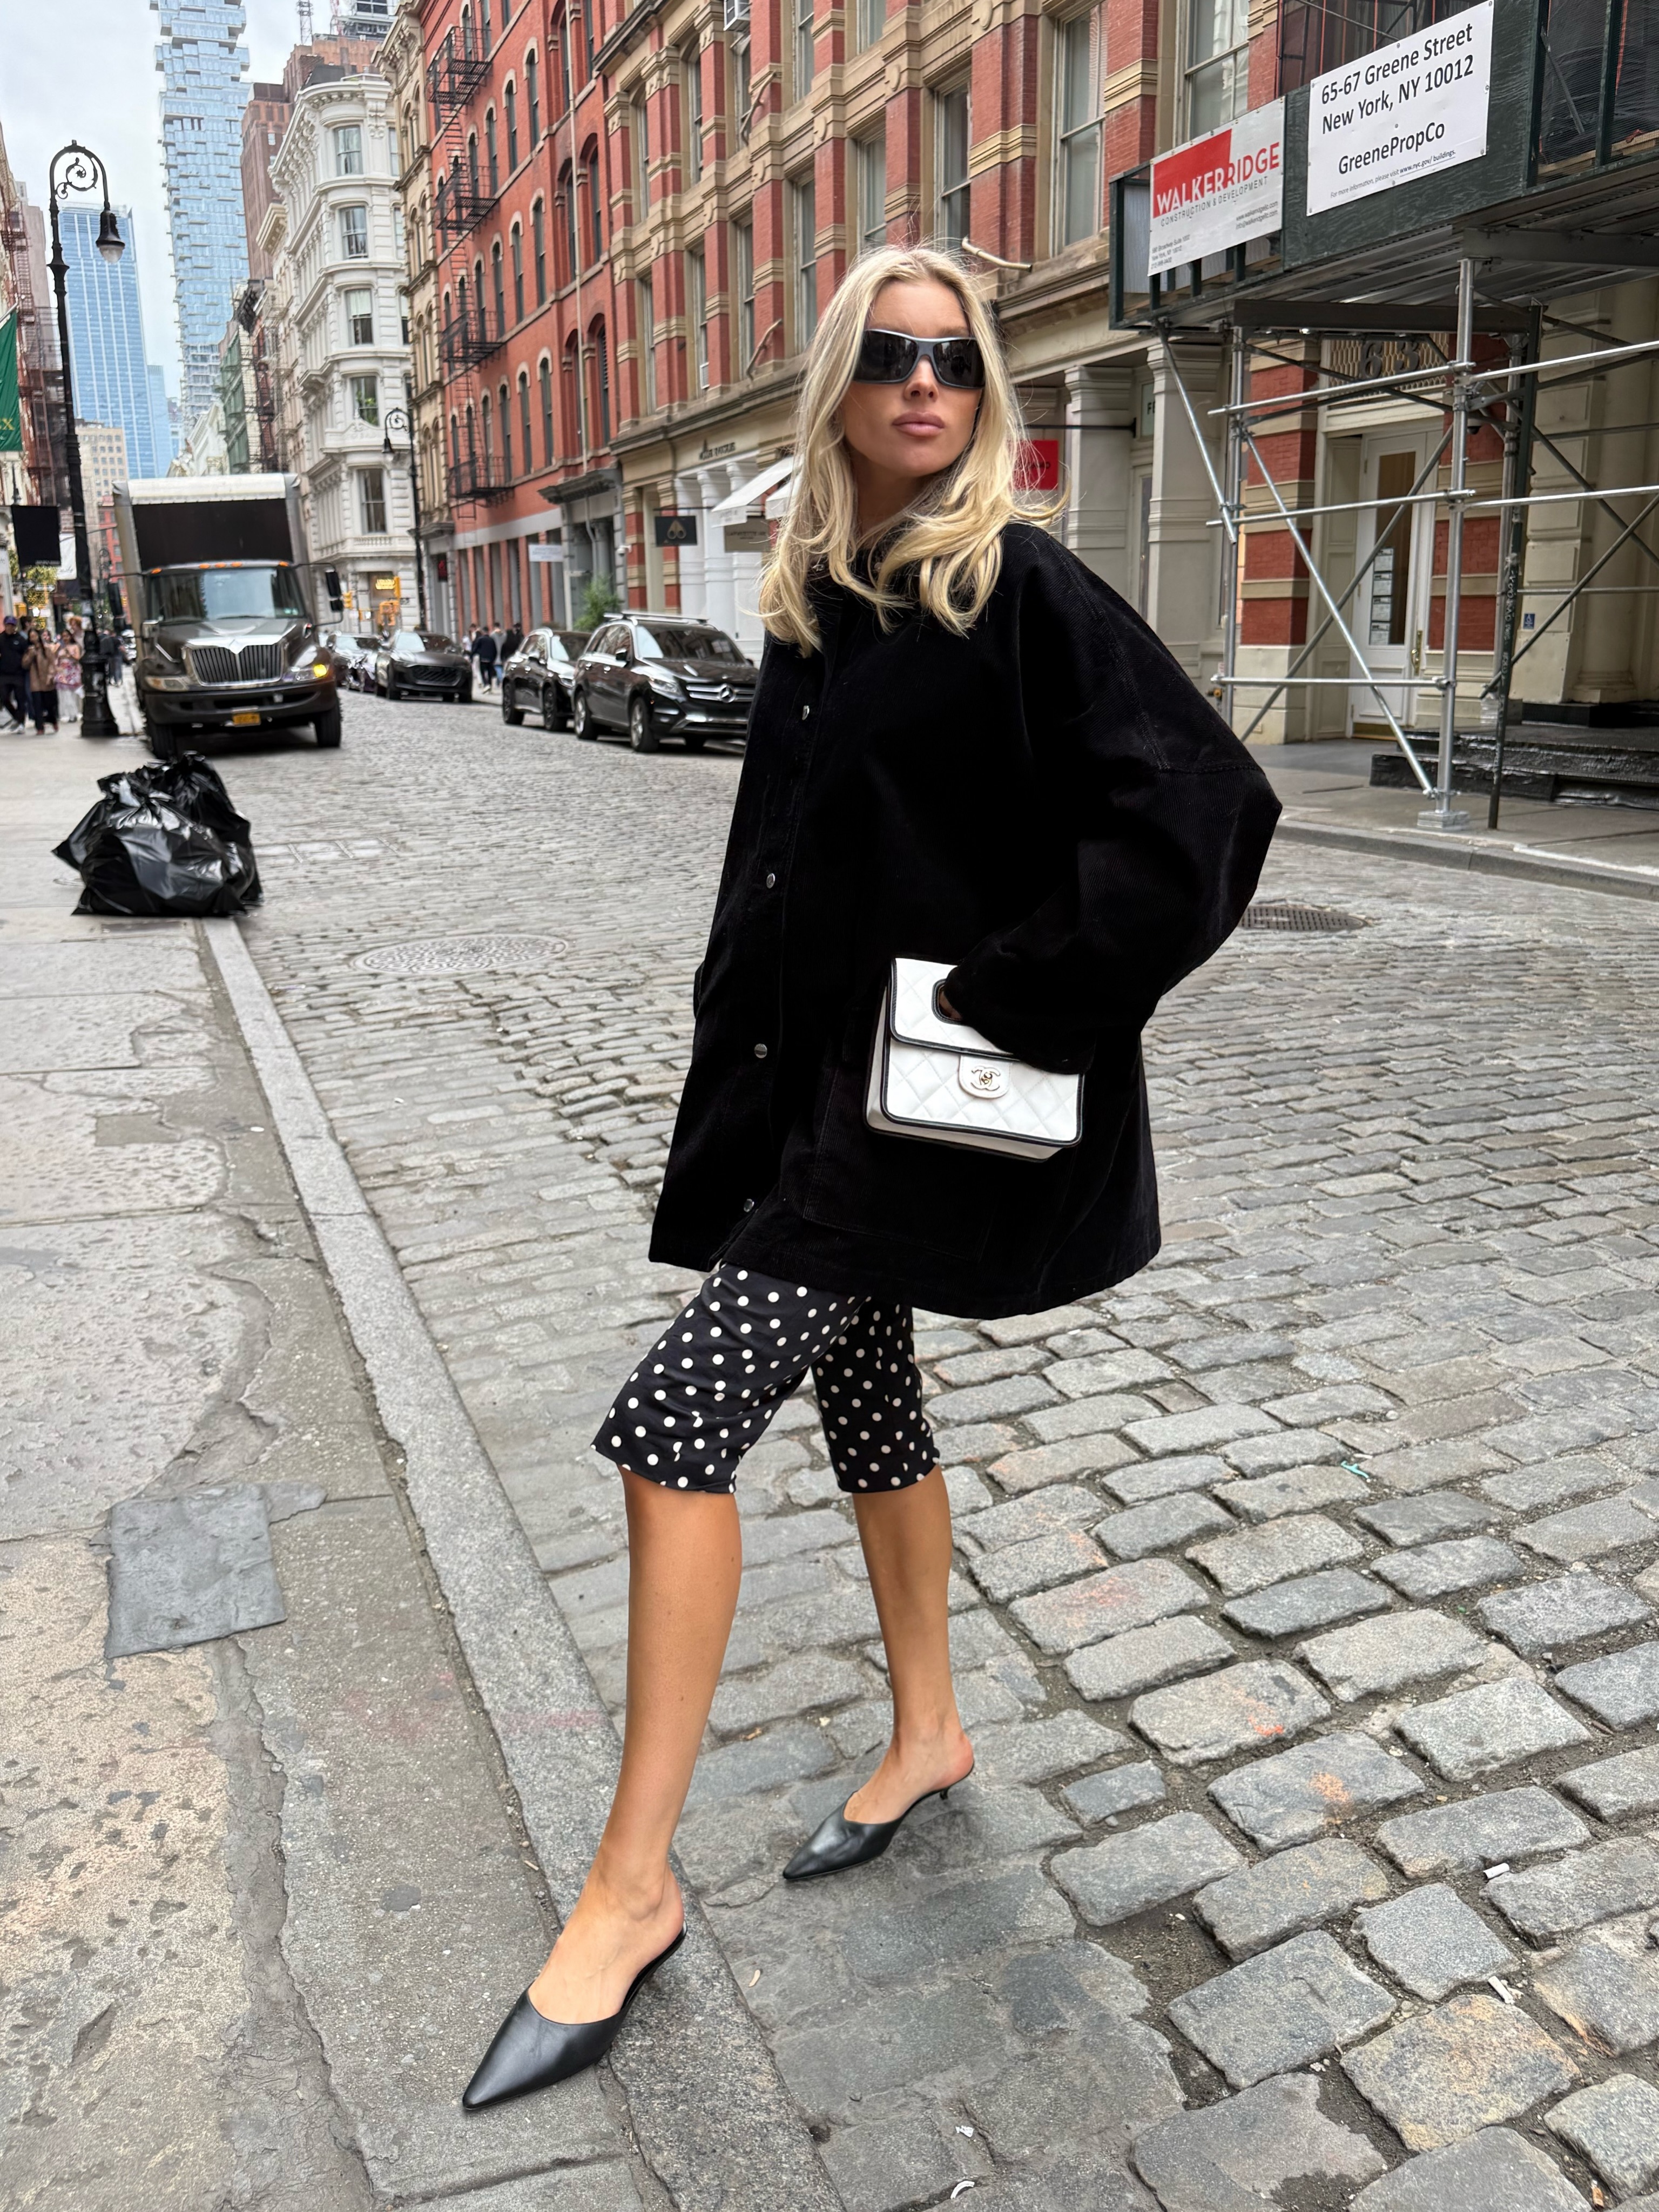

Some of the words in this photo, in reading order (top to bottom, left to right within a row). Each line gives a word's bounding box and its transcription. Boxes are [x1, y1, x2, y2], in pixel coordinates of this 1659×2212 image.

[1321, 70, 1361, 105] 65-67
[1365, 50, 1419, 86] Greene
[1423, 23, 1473, 61] Street
[1322, 109, 1354, 135] New
[1358, 90, 1393, 119] York,
[1398, 76, 1421, 104] NY
[1425, 54, 1474, 93] 10012
[1156, 141, 1280, 216] WALKERRIDGE
[1338, 122, 1445, 175] GreenePropCo
[1375, 172, 1389, 184] please
[1161, 199, 1211, 227] CONSTRUCTION
[1212, 196, 1217, 206] &
[1218, 176, 1269, 204] DEVELOPMENT
